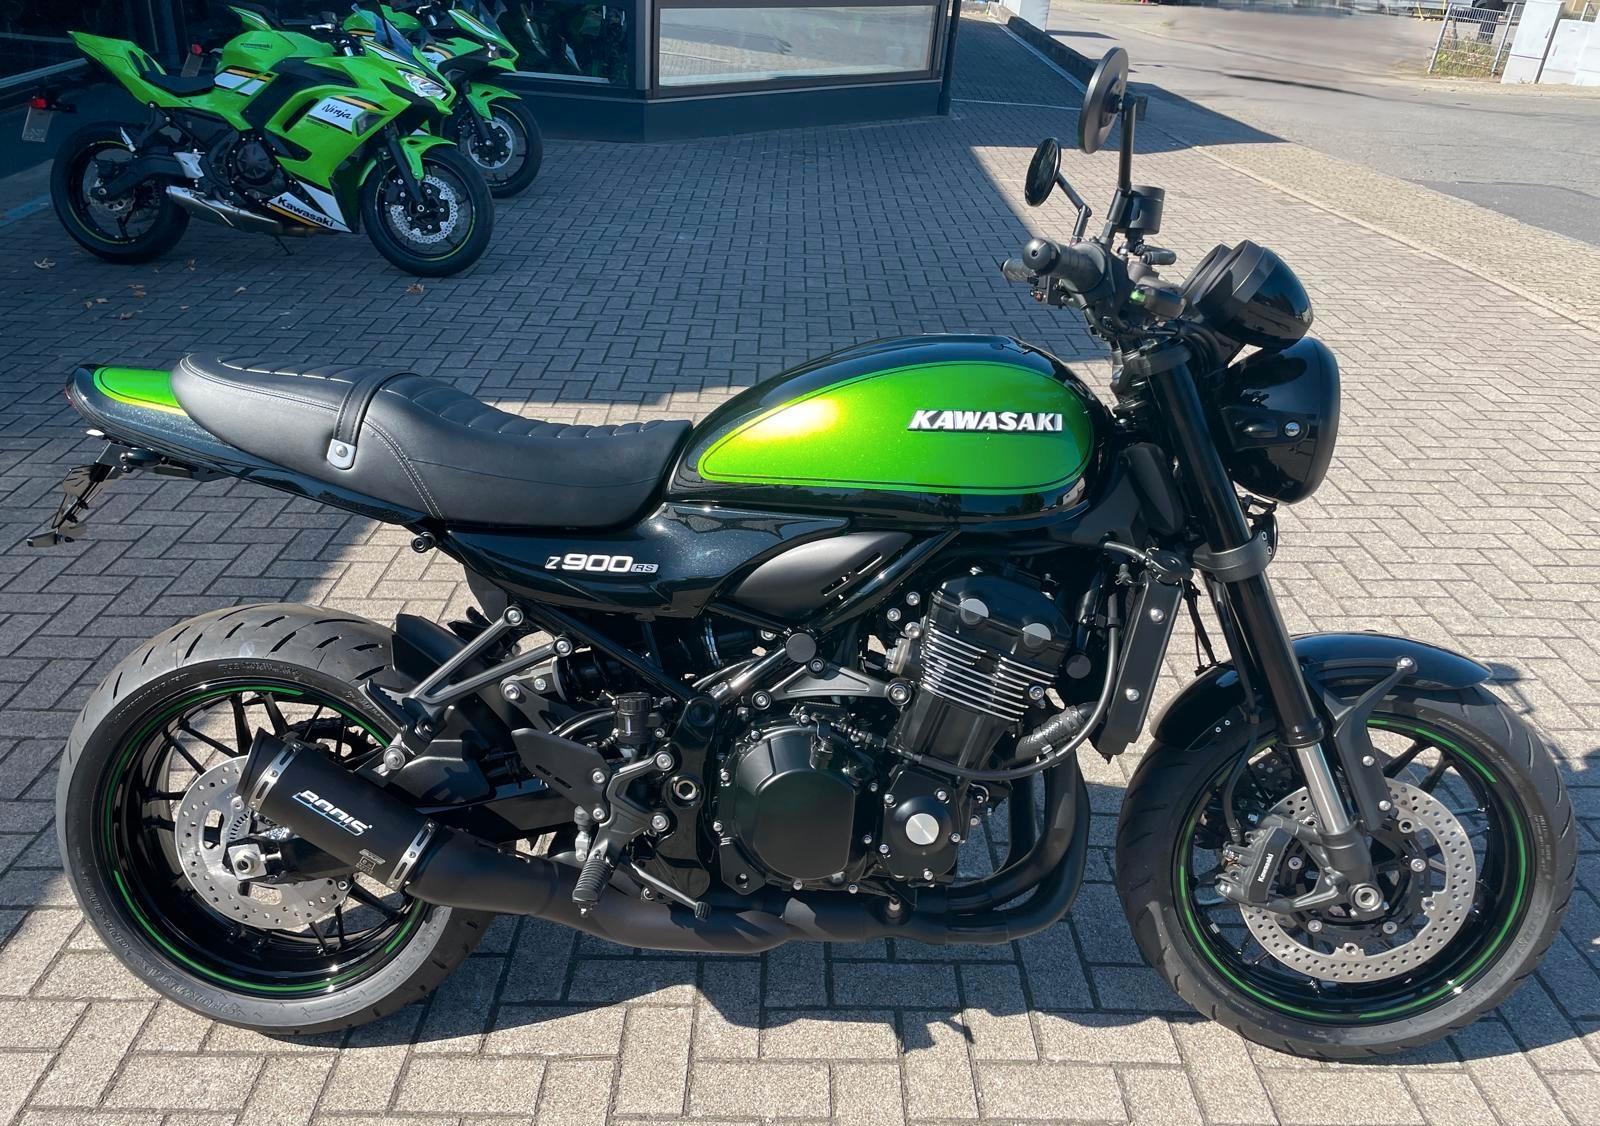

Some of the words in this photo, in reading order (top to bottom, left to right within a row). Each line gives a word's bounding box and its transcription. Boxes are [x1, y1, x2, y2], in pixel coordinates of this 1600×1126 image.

[321, 104, 352, 119] Ninja
[277, 197, 334, 227] Kawasaki
[907, 410, 1063, 431] KAWASAKI
[292, 790, 369, 836] BODIS
